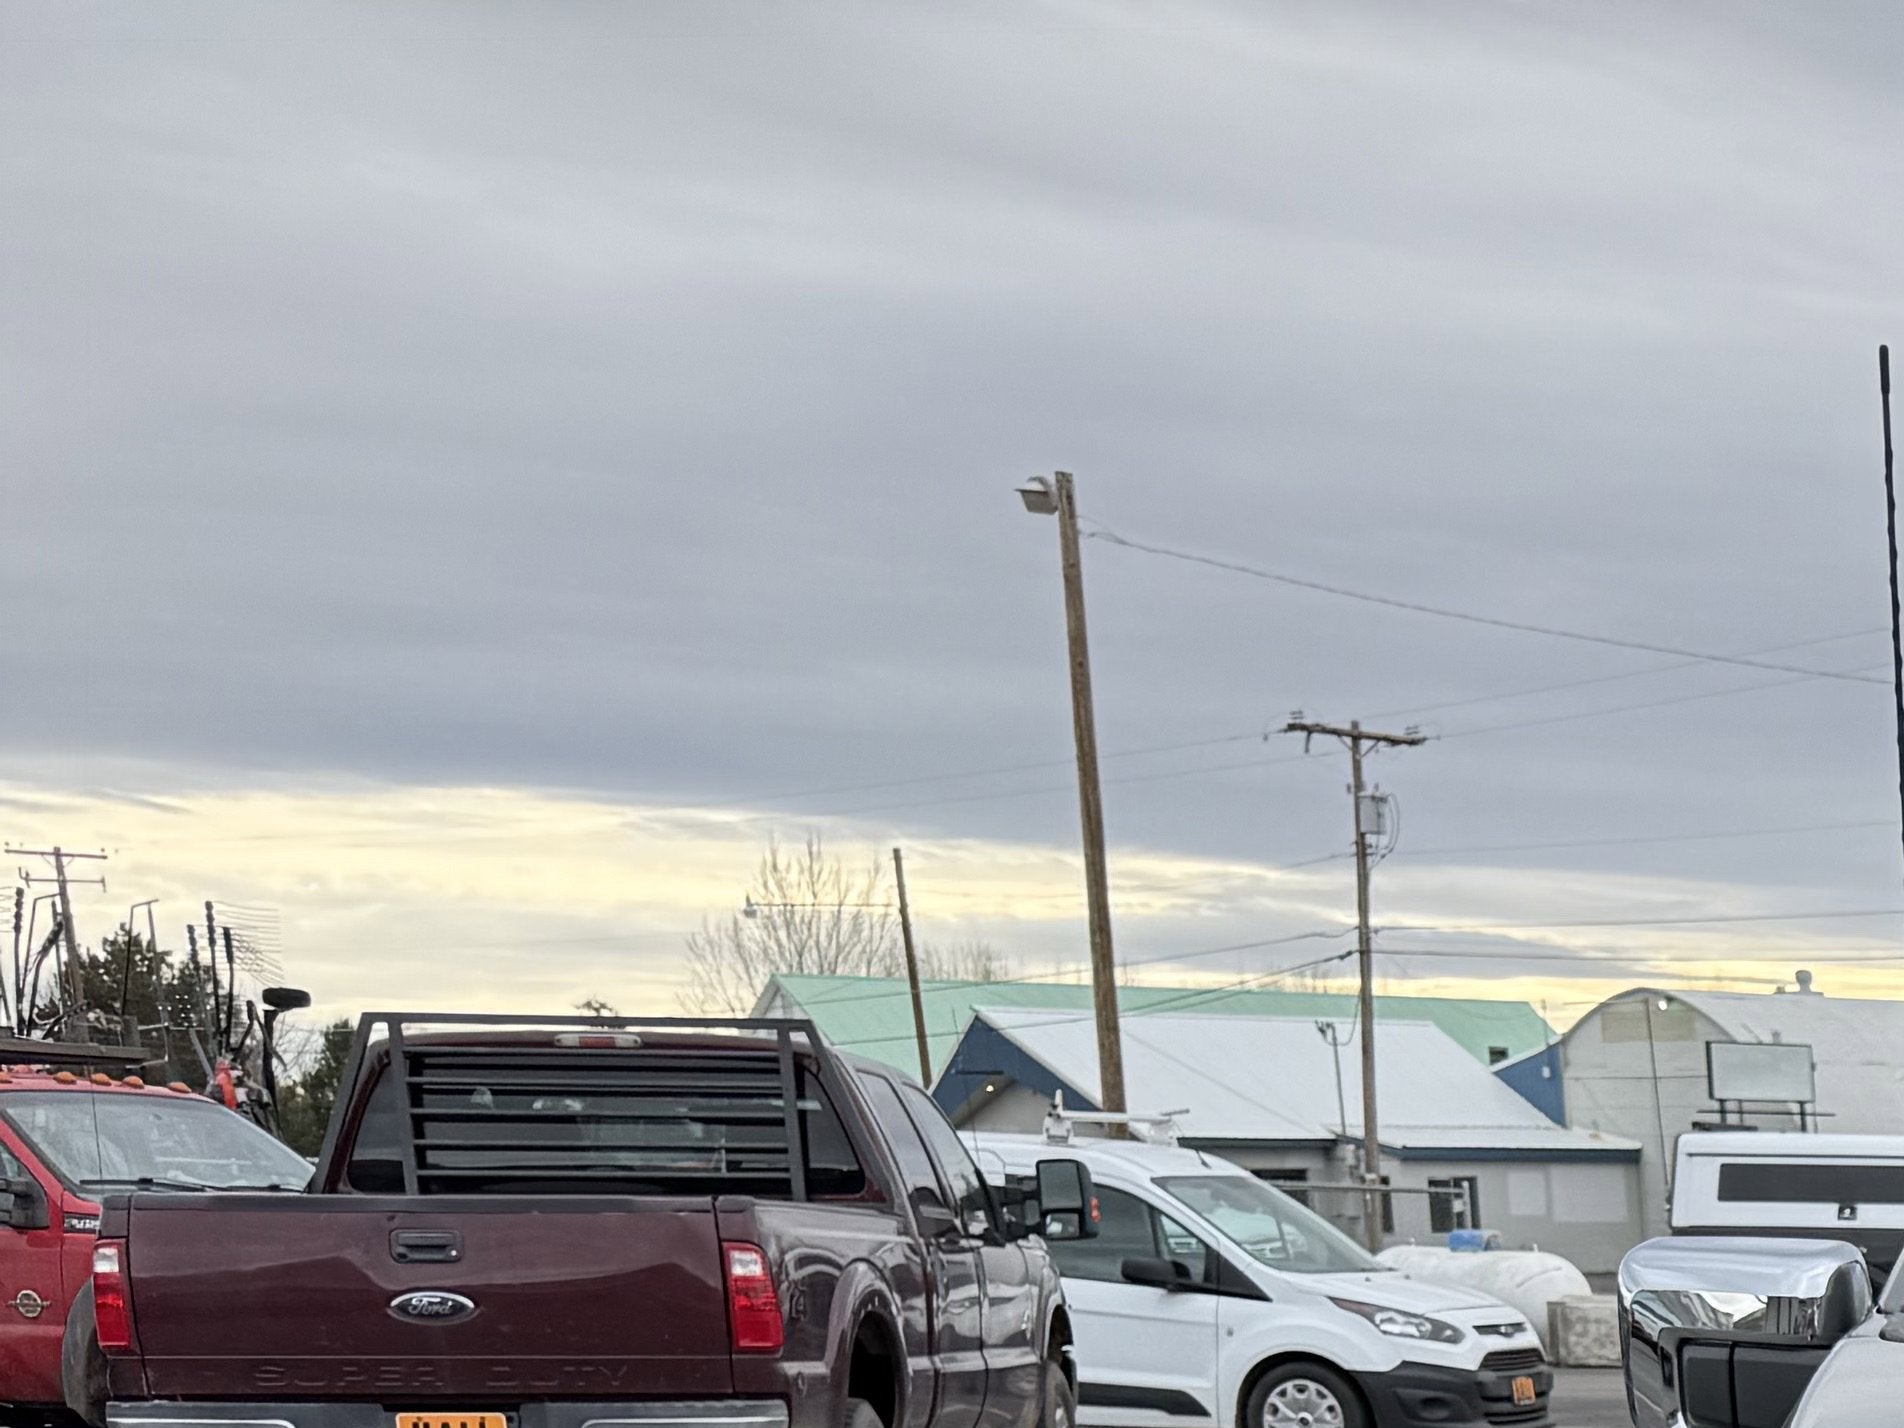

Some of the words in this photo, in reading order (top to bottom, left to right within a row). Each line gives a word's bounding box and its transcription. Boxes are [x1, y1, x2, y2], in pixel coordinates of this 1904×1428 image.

[408, 1297, 453, 1316] Ford
[254, 1366, 444, 1386] SUPER
[486, 1365, 627, 1386] DUTY
